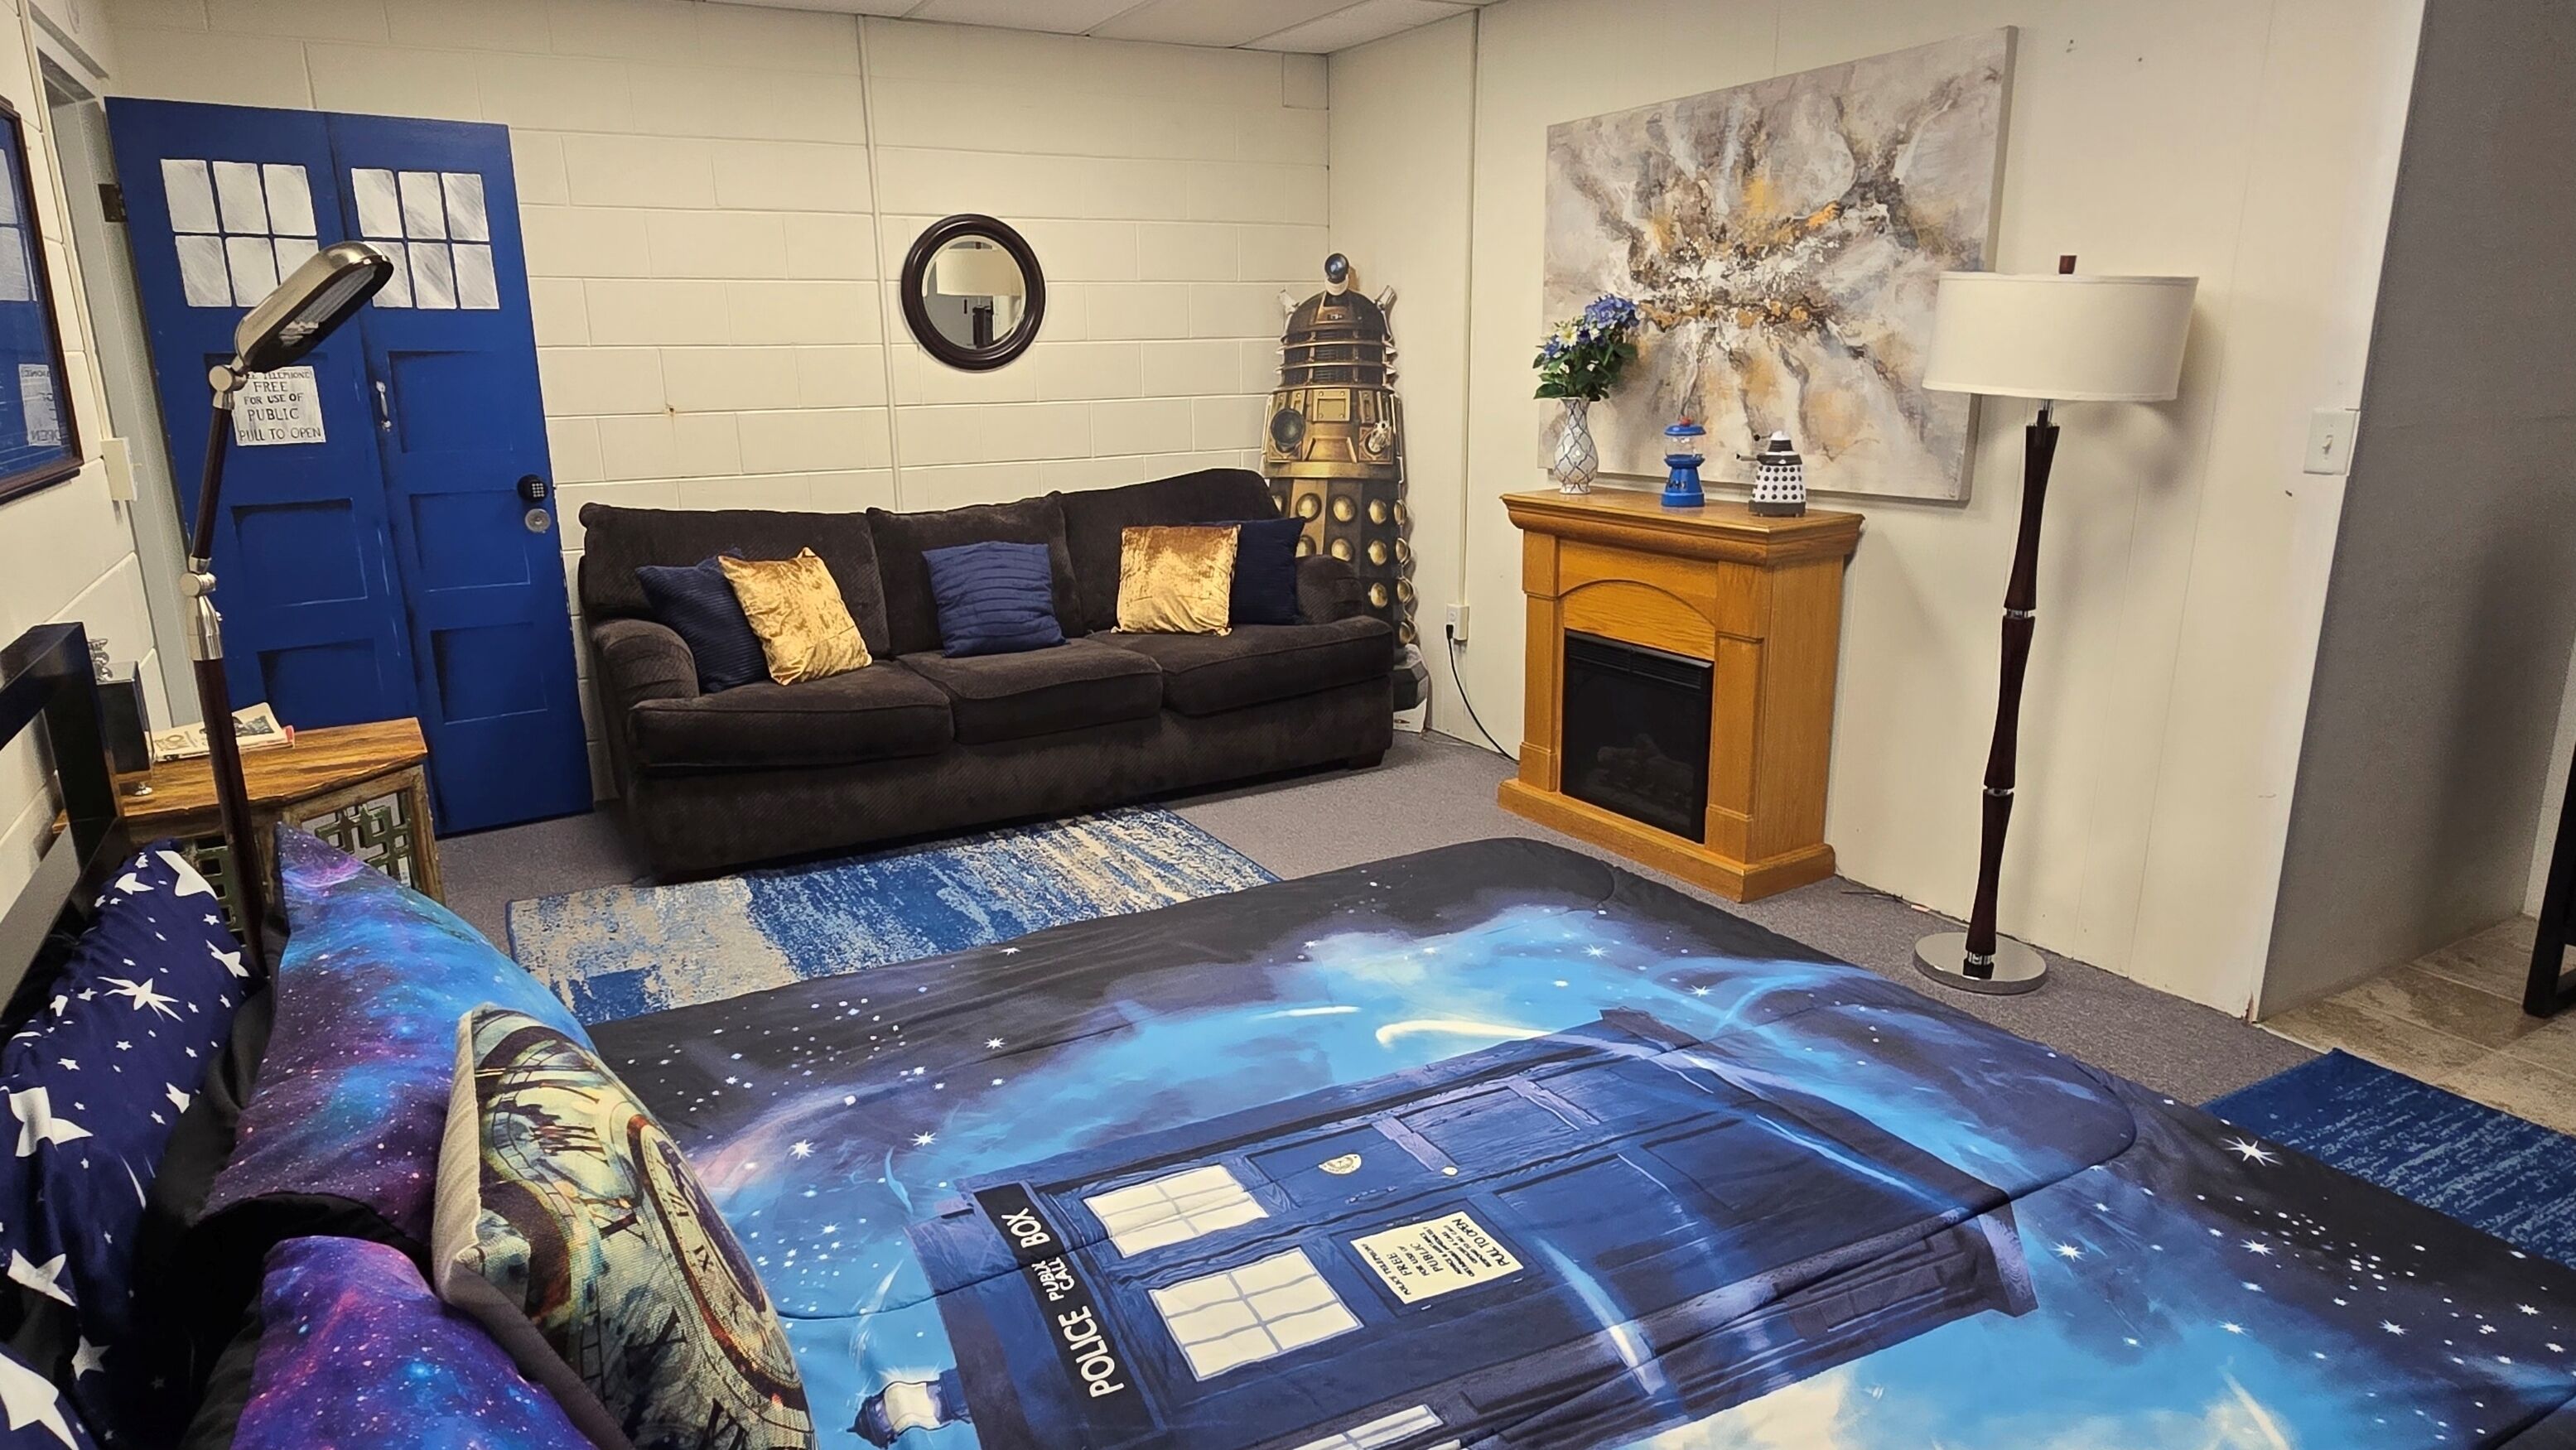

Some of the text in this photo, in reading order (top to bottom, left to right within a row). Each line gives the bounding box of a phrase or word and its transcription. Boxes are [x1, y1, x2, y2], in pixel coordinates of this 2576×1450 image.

[253, 381, 288, 393] FREE
[244, 393, 304, 405] FOR USE OF
[247, 407, 300, 422] PUBLIC
[239, 427, 321, 441] PULL TO OPEN
[1001, 1207, 1050, 1248] BOX
[1452, 1219, 1478, 1237] OPEN
[1474, 1237, 1489, 1248] TO
[1387, 1253, 1412, 1275] FREE
[1411, 1244, 1444, 1272] PUBLIC
[1486, 1247, 1510, 1266] PULL
[1048, 1256, 1075, 1291] CALL
[1058, 1305, 1125, 1397] POLICE
